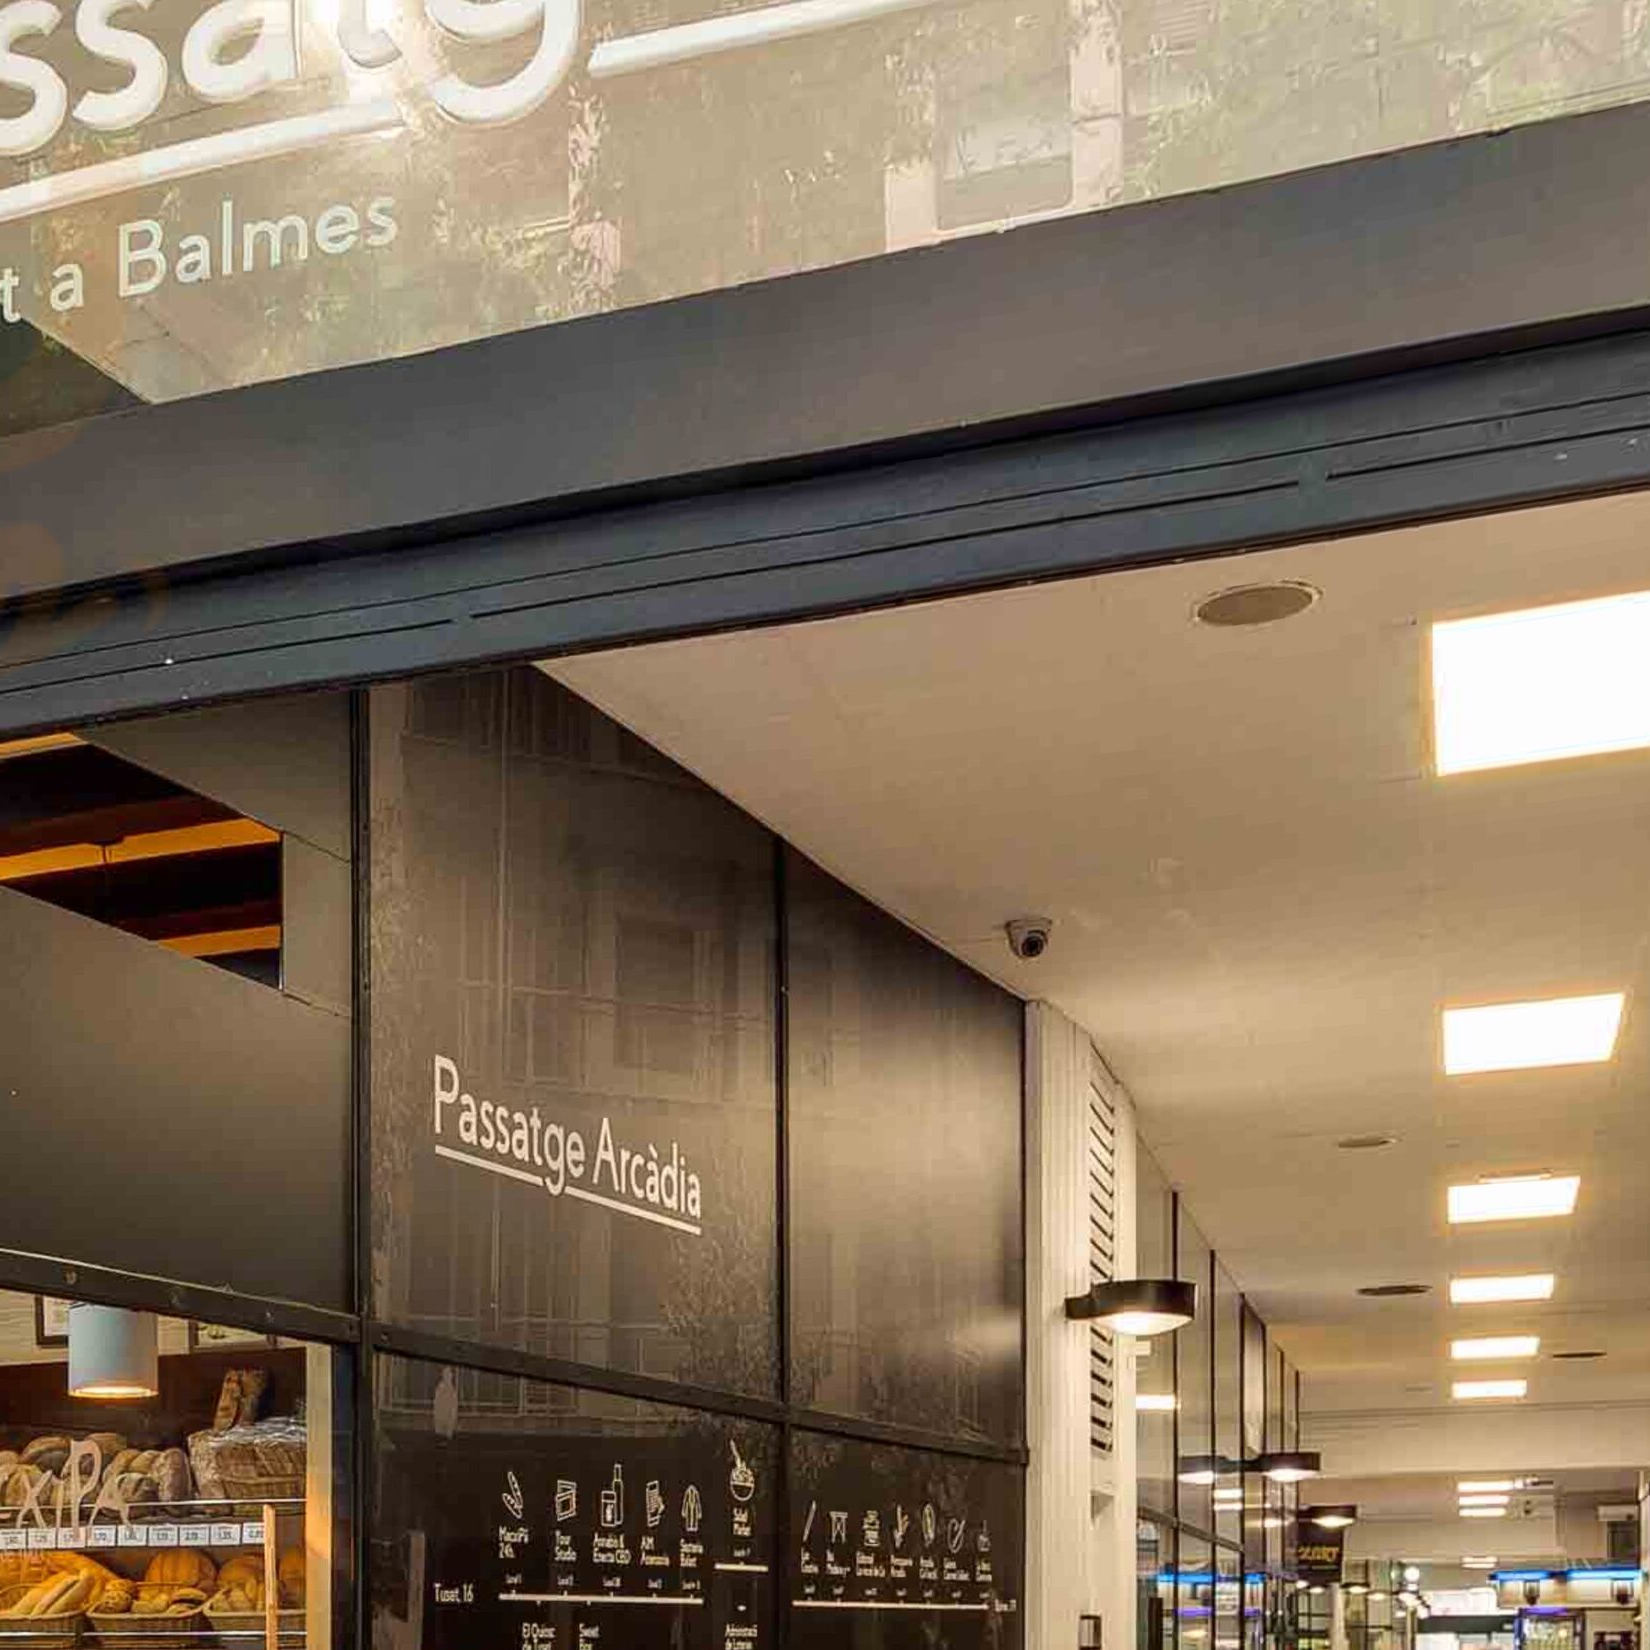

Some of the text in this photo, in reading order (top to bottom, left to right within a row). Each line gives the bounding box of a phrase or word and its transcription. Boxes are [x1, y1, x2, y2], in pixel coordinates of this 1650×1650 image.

[50, 258, 86, 313] a
[116, 196, 400, 298] Balmes
[434, 1054, 702, 1220] Passatge Arcàdia
